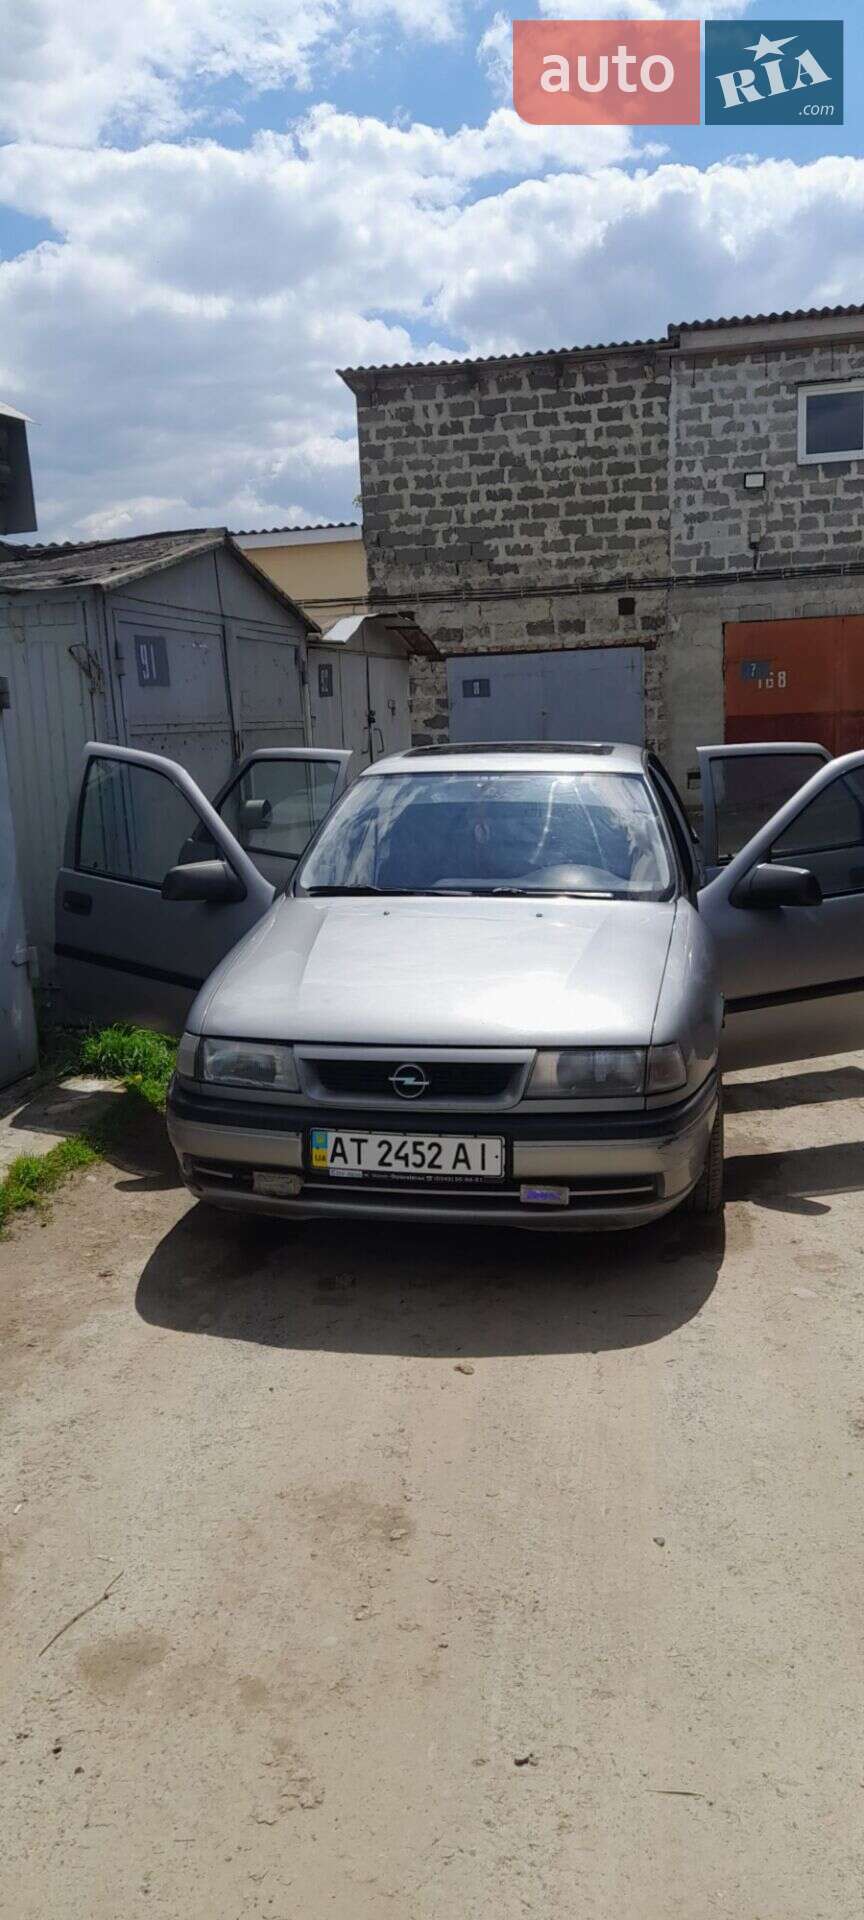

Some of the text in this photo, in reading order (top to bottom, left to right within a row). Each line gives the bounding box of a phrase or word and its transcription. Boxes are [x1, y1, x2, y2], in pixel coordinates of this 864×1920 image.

[139, 644, 157, 680] 91
[750, 663, 757, 677] 7
[313, 1154, 328, 1163] UA
[330, 1137, 486, 1171] AT 2452 AI
